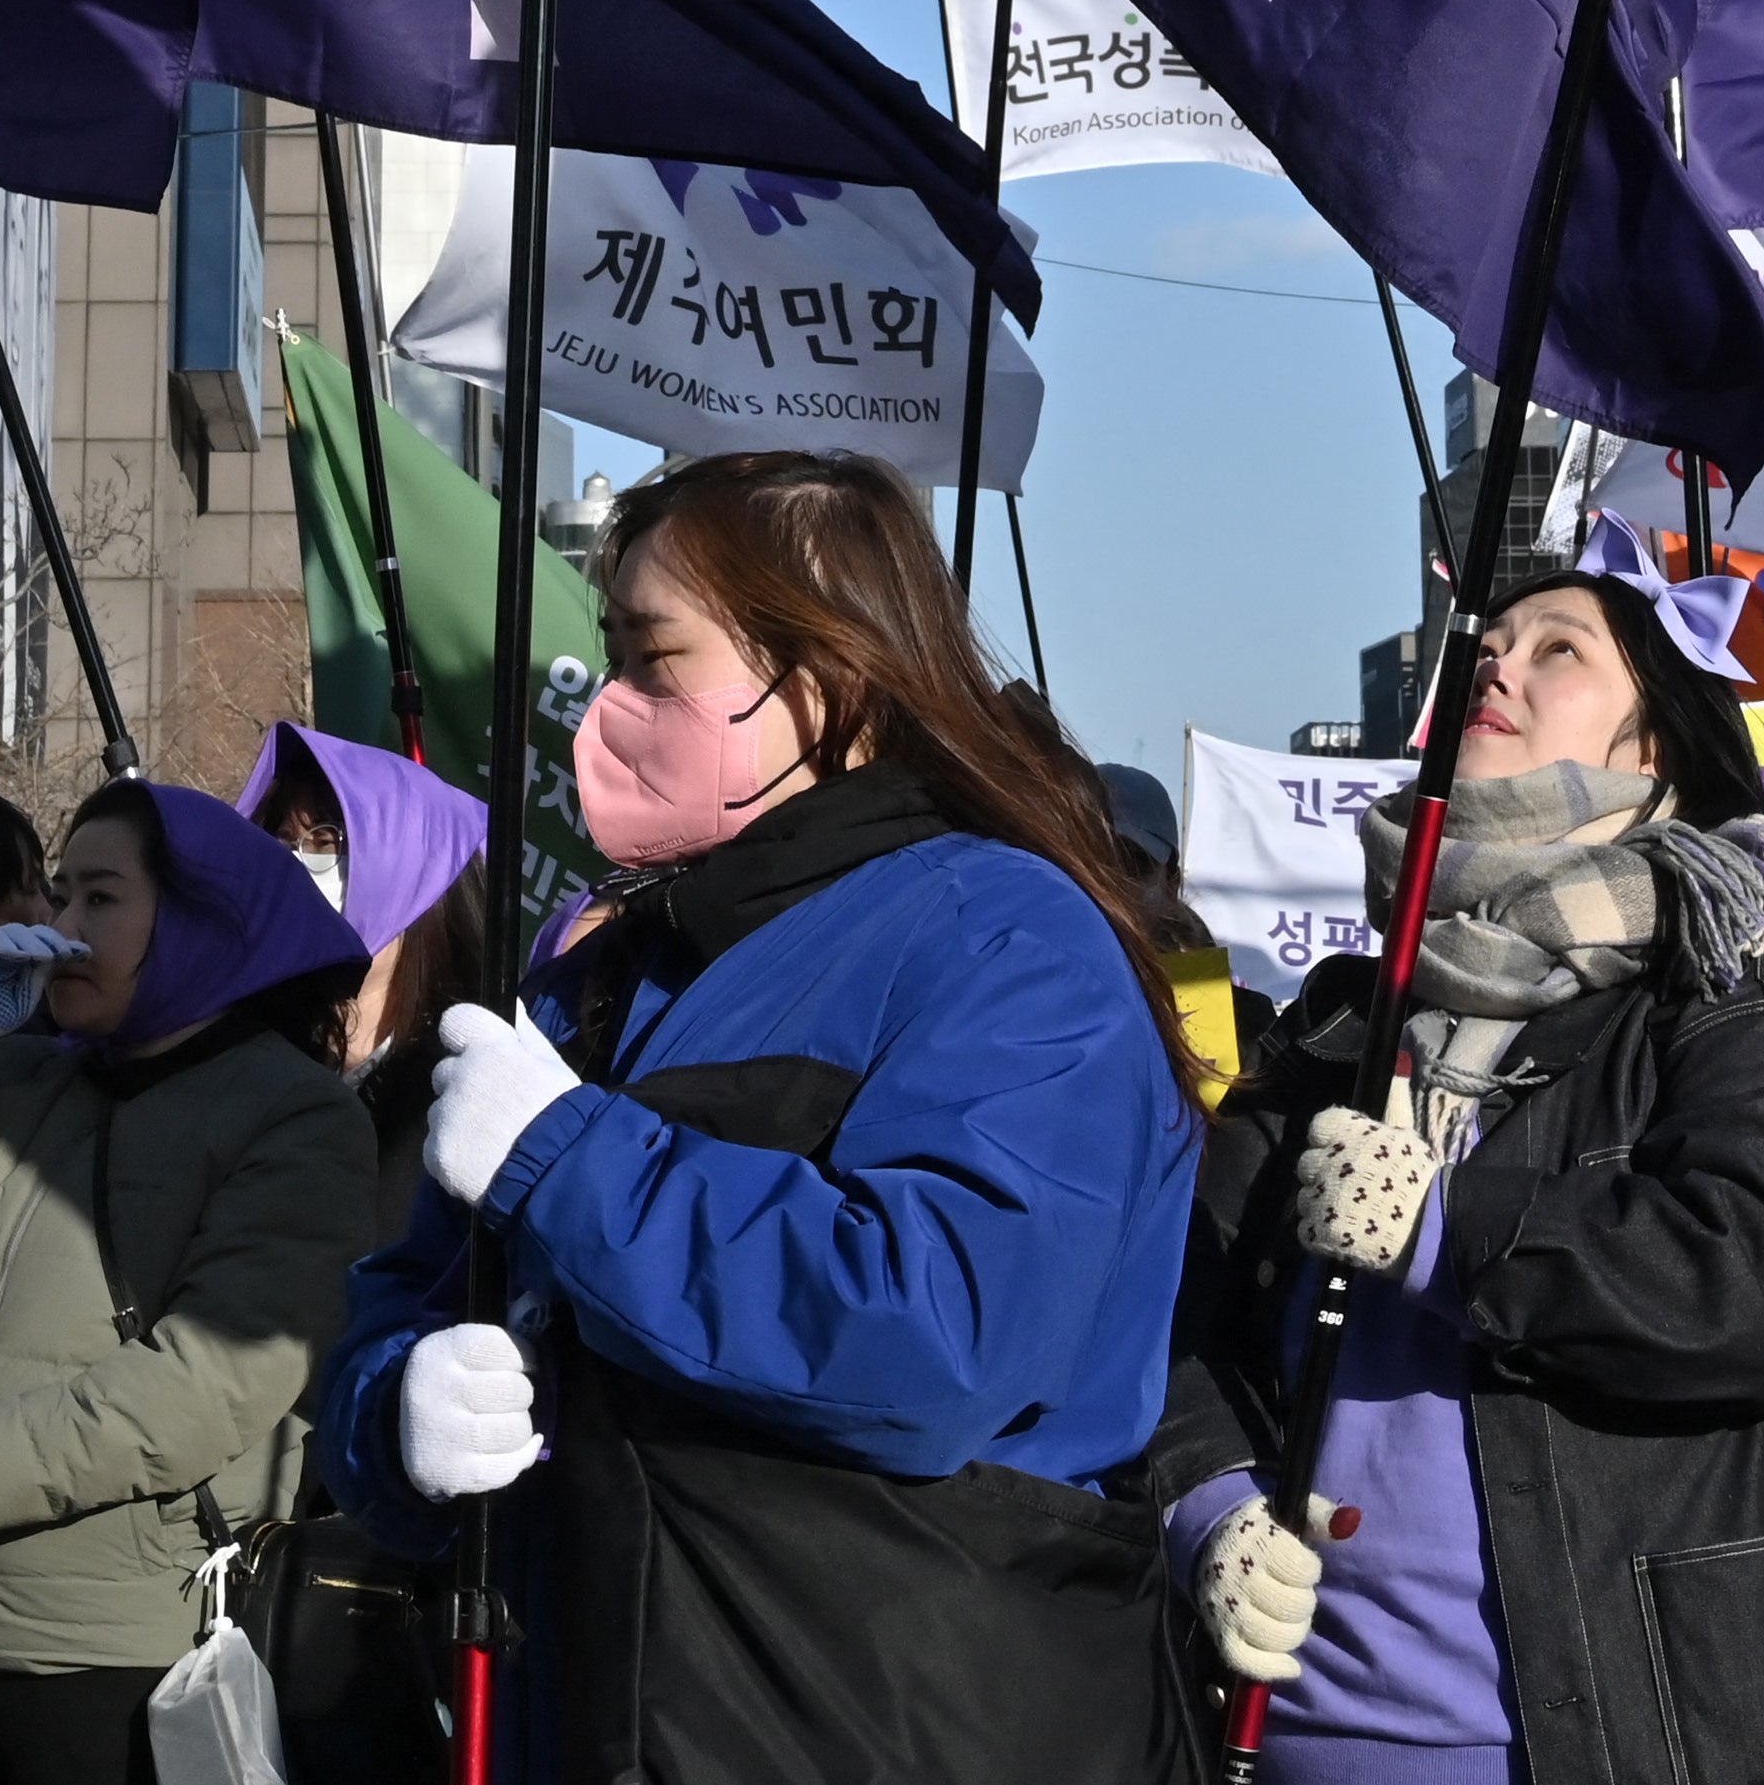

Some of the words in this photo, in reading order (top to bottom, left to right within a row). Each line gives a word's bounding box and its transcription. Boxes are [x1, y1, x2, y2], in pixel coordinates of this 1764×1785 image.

[1013, 120, 1082, 146] Korean
[1086, 108, 1224, 133] Association
[582, 229, 937, 369] 제주여민회
[545, 329, 616, 376] JEJU
[630, 359, 765, 416] WOMEN'S
[775, 392, 941, 423] ASSOCIATION
[1317, 1310, 1344, 1326] 360
